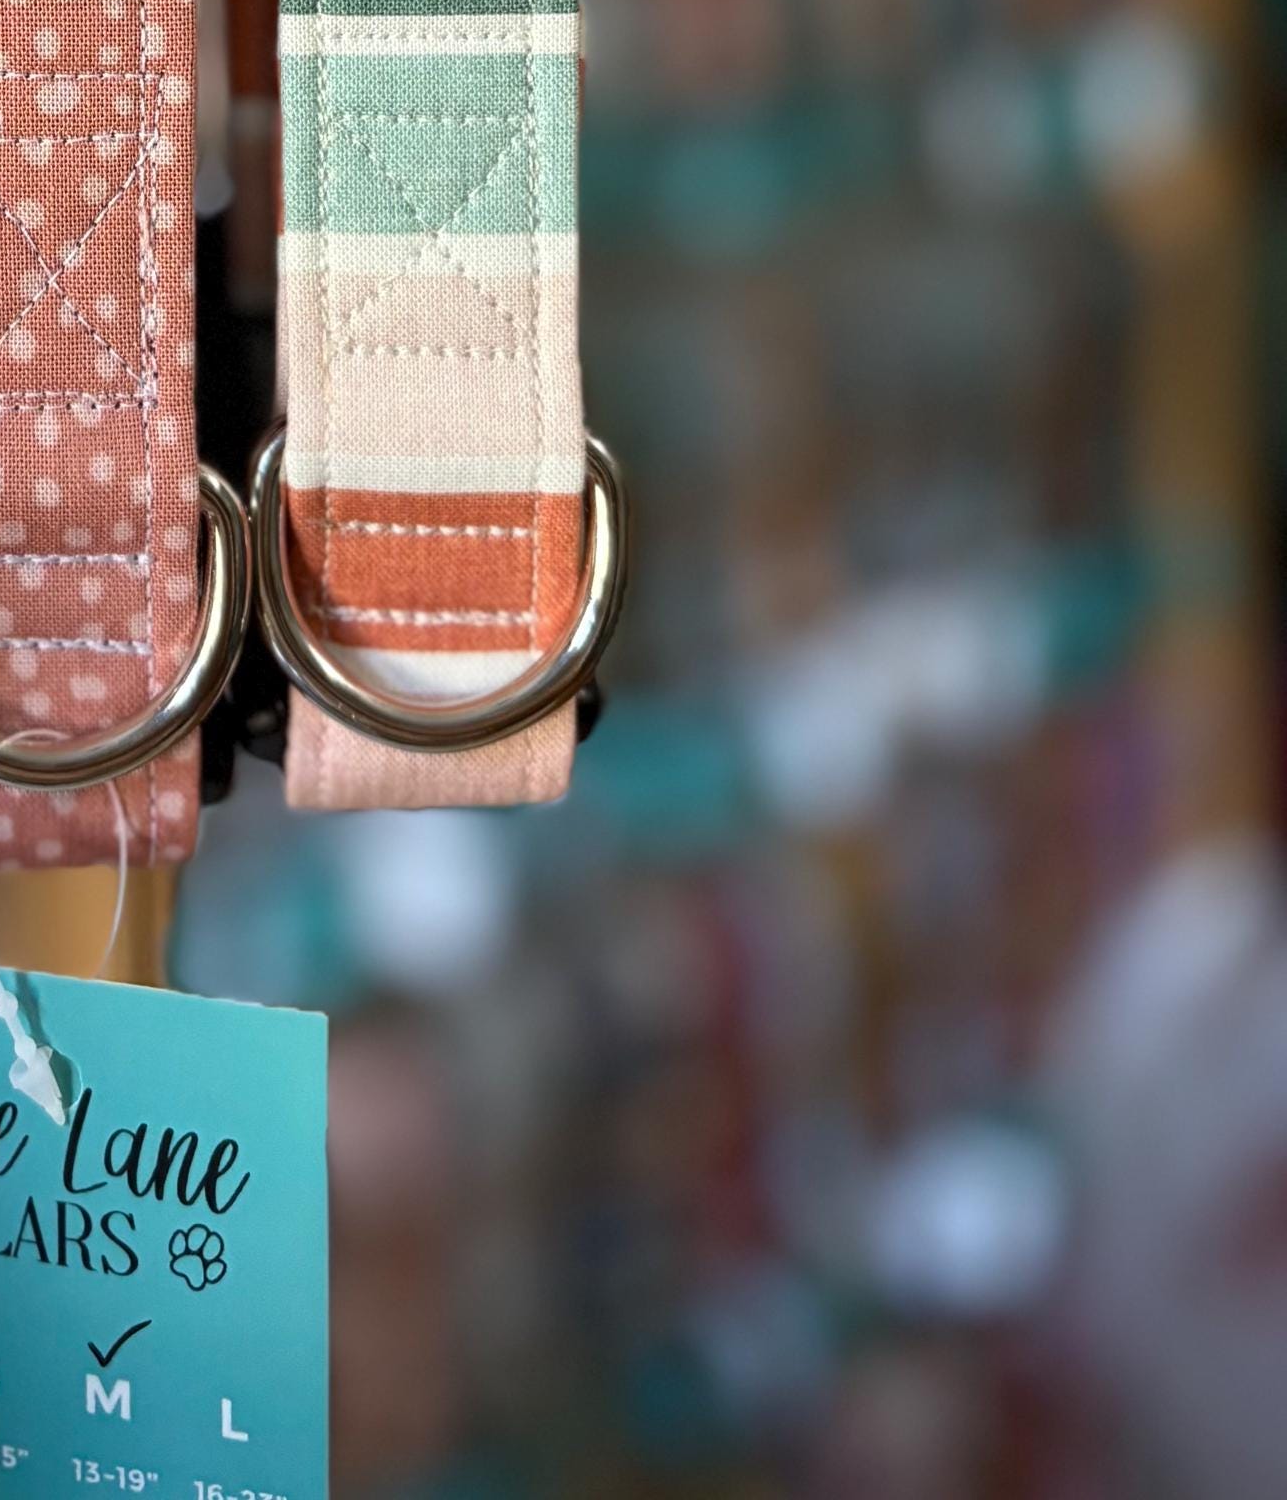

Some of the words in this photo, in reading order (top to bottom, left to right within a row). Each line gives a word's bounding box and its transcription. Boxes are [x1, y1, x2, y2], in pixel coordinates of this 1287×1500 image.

[62, 1086, 252, 1215] Lane
[83, 1372, 132, 1422] M
[219, 1396, 250, 1443] L
[71, 1457, 160, 1493] 13-19"
